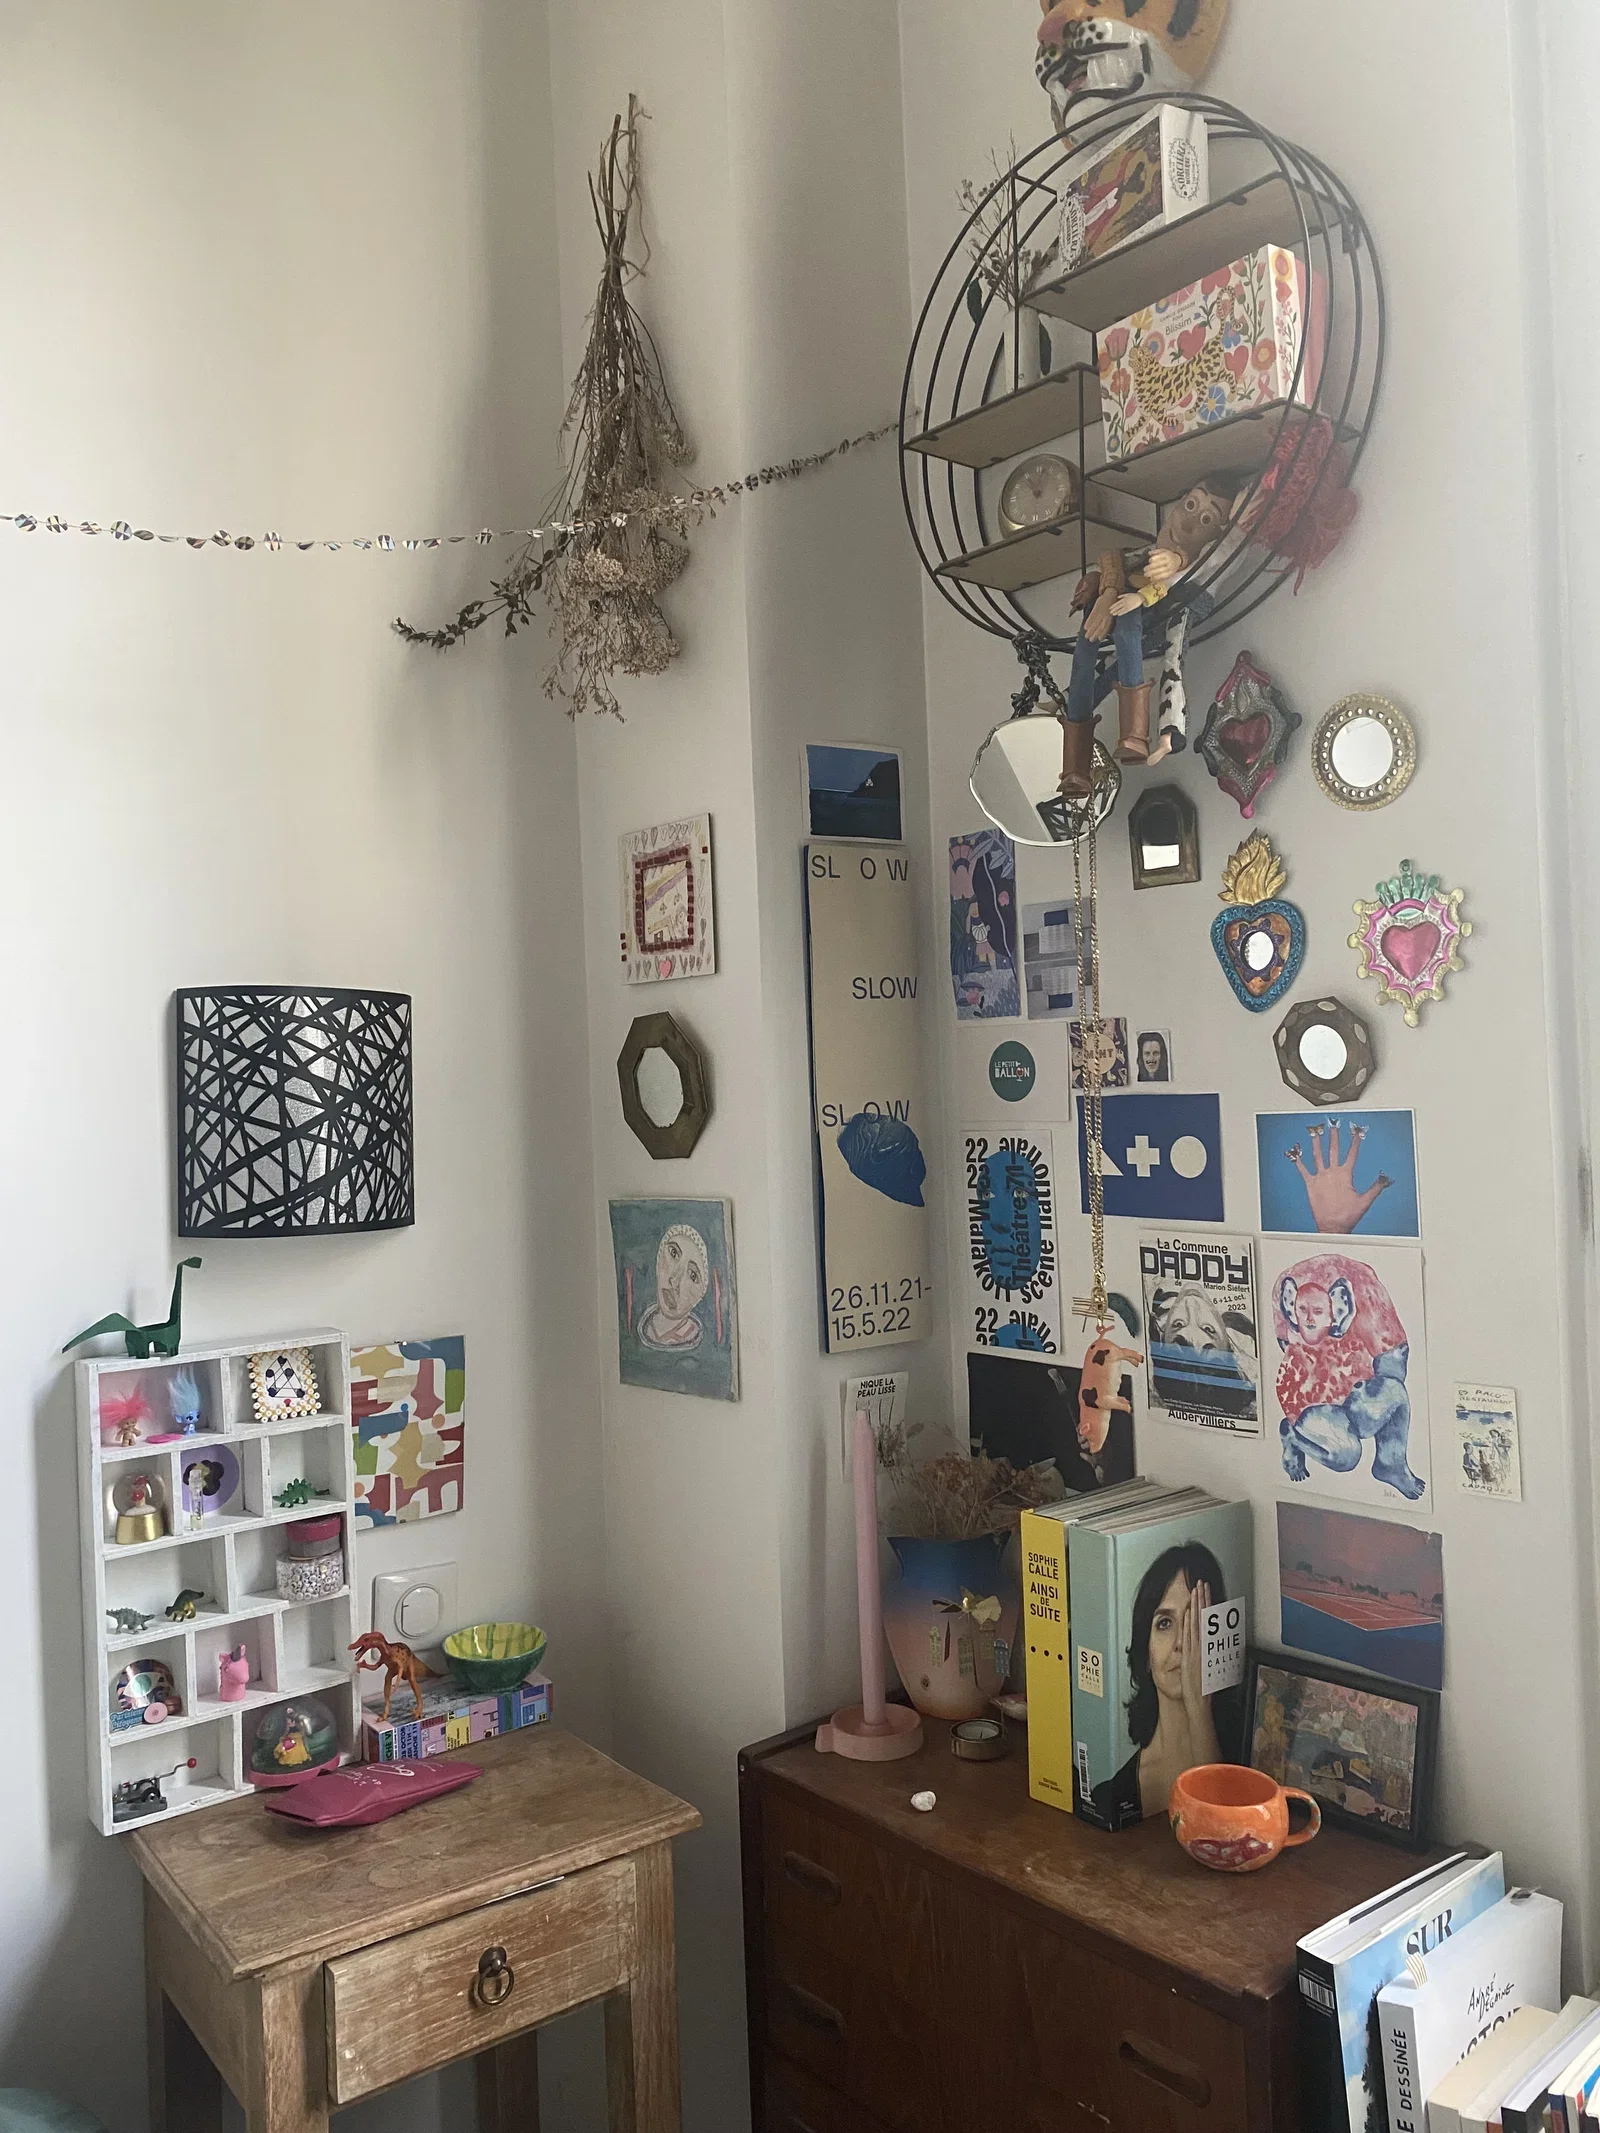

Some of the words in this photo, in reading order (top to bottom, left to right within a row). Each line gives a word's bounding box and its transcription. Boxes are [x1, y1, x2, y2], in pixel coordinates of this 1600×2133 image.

[1165, 317, 1192, 336] Blissim
[852, 976, 918, 1000] SLOW
[1085, 1049, 1114, 1060] MNT
[965, 1137, 989, 1163] 22
[968, 1199, 1012, 1303] Malakoff
[1157, 1237, 1170, 1250] La
[1172, 1238, 1228, 1254] Commune
[1139, 1246, 1249, 1285] DADDY
[831, 1276, 932, 1312] 26.11.21-
[1203, 1282, 1226, 1291] Marion
[1227, 1284, 1251, 1293] Siéfert
[1227, 1303, 1247, 1311] 2023
[832, 1306, 911, 1341] 15.5.22
[975, 1306, 999, 1334] 22
[857, 1388, 876, 1398] PEAU
[878, 1385, 896, 1395] LISSE
[860, 1378, 884, 1389] NIQUE
[885, 1377, 894, 1386] LA
[1459, 1396, 1514, 1404] RESTAURANT
[1168, 1408, 1236, 1429] Aubervilliers
[1028, 1551, 1058, 1568] SOPHIE
[1028, 1562, 1059, 1580] CALLE
[1030, 1581, 1058, 1600] AINSI
[1040, 1596, 1050, 1606] DE
[1030, 1603, 1061, 1623] SUITE
[1207, 1633, 1240, 1655] PHIE
[1207, 1650, 1240, 1668] CALLE
[1080, 1664, 1100, 1677] PHIE
[1406, 1908, 1453, 1956] SUR
[1390, 2028, 1413, 2111] DESSINÉE
